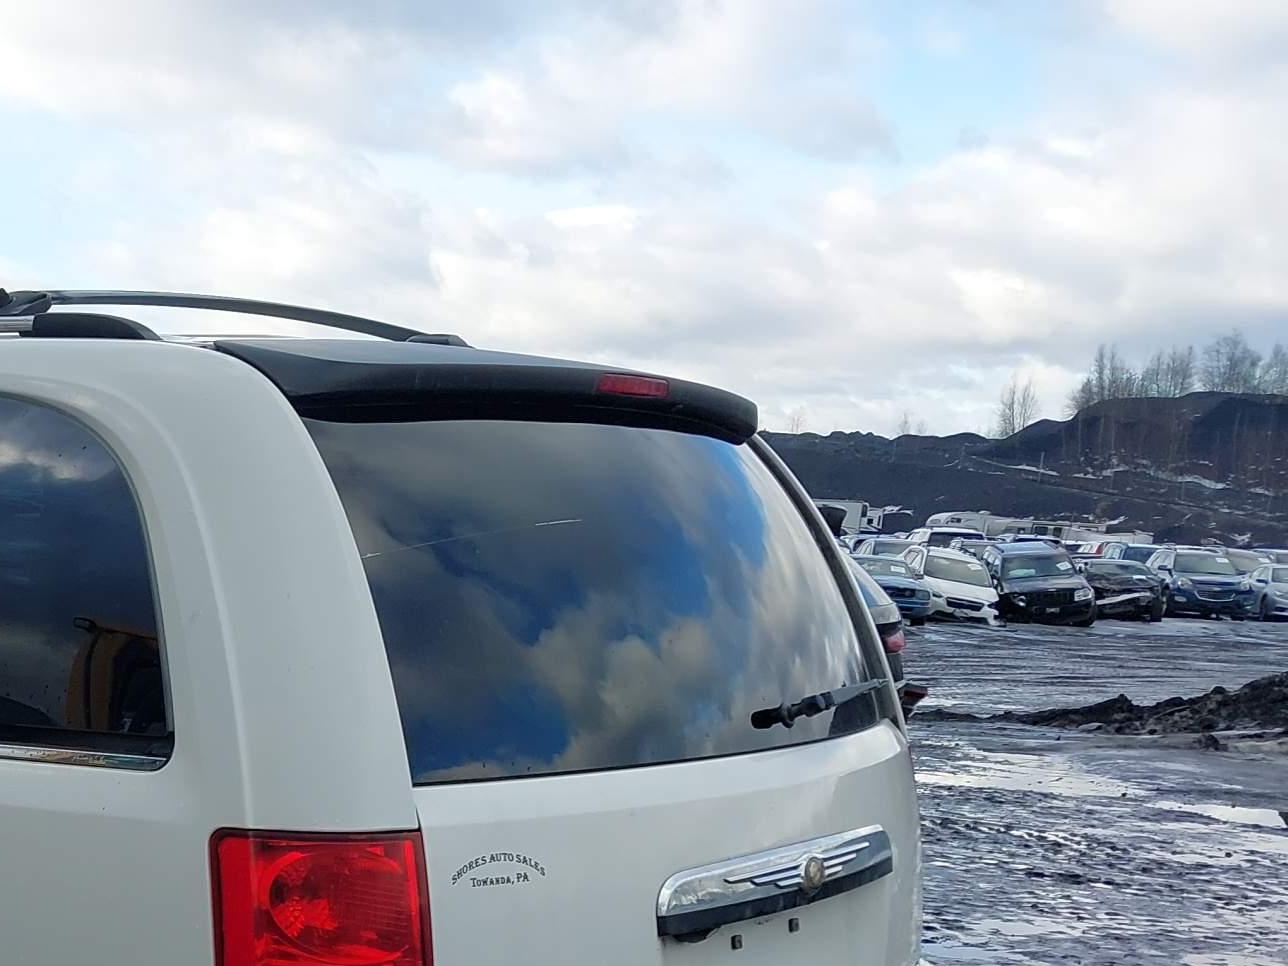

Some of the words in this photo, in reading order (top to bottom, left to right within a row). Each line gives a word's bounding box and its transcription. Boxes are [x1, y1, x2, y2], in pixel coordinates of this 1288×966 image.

[451, 855, 487, 885] SHORES
[488, 852, 514, 863] AUTO
[515, 854, 546, 876] SALES
[516, 872, 530, 883] PA
